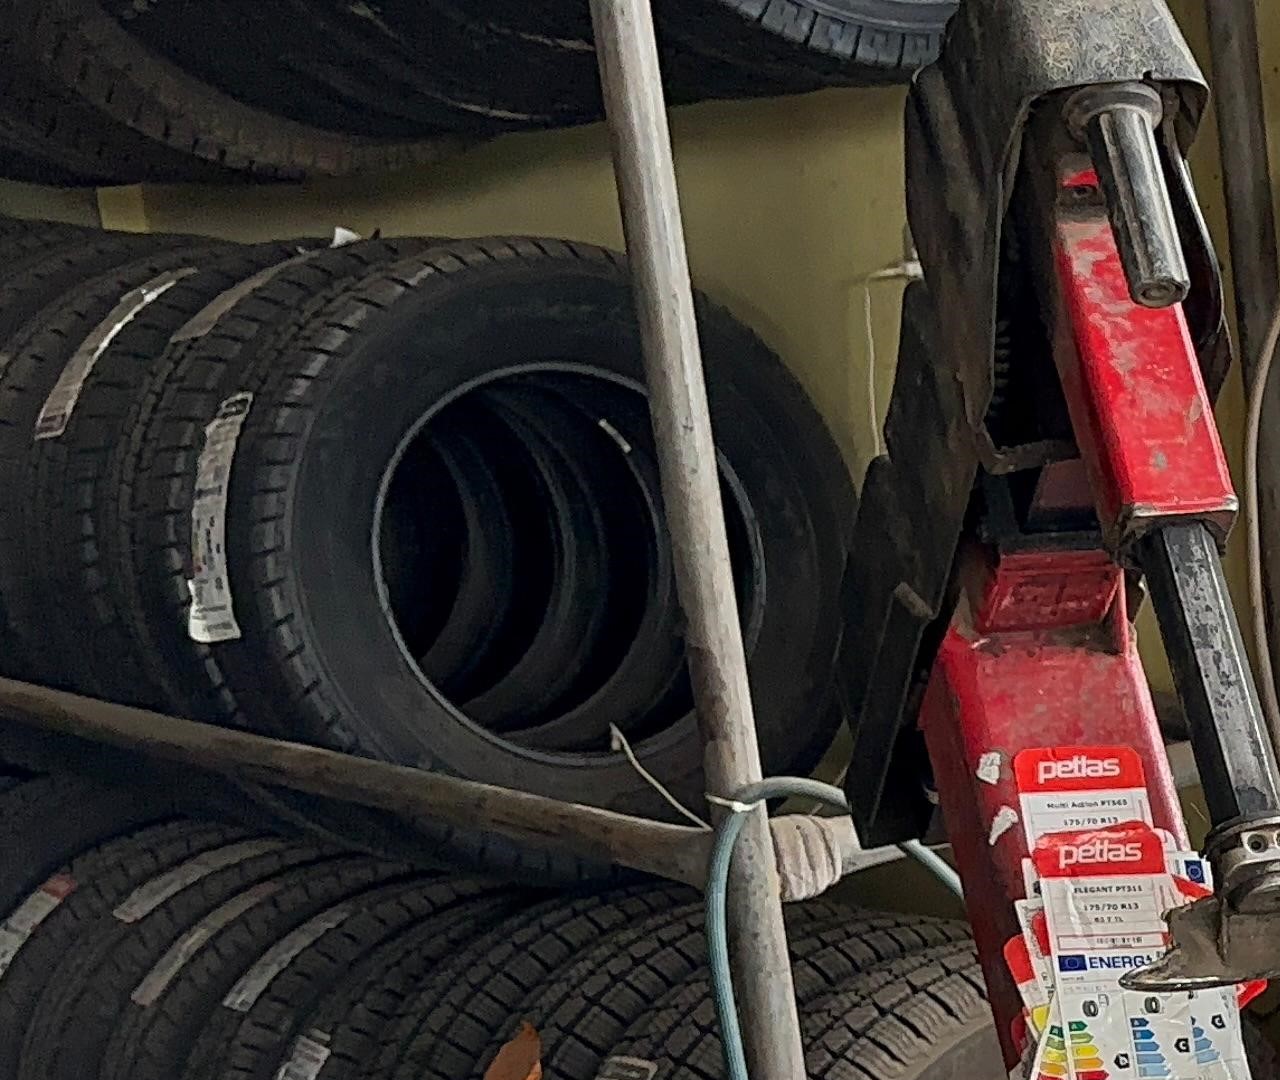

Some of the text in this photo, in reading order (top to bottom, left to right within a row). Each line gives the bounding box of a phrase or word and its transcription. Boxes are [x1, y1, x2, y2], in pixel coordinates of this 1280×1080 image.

[1038, 755, 1120, 785] petlas
[1058, 840, 1142, 870] petlas
[1074, 886, 1113, 894] ELEGANT
[1084, 902, 1140, 912] 175/70 R13
